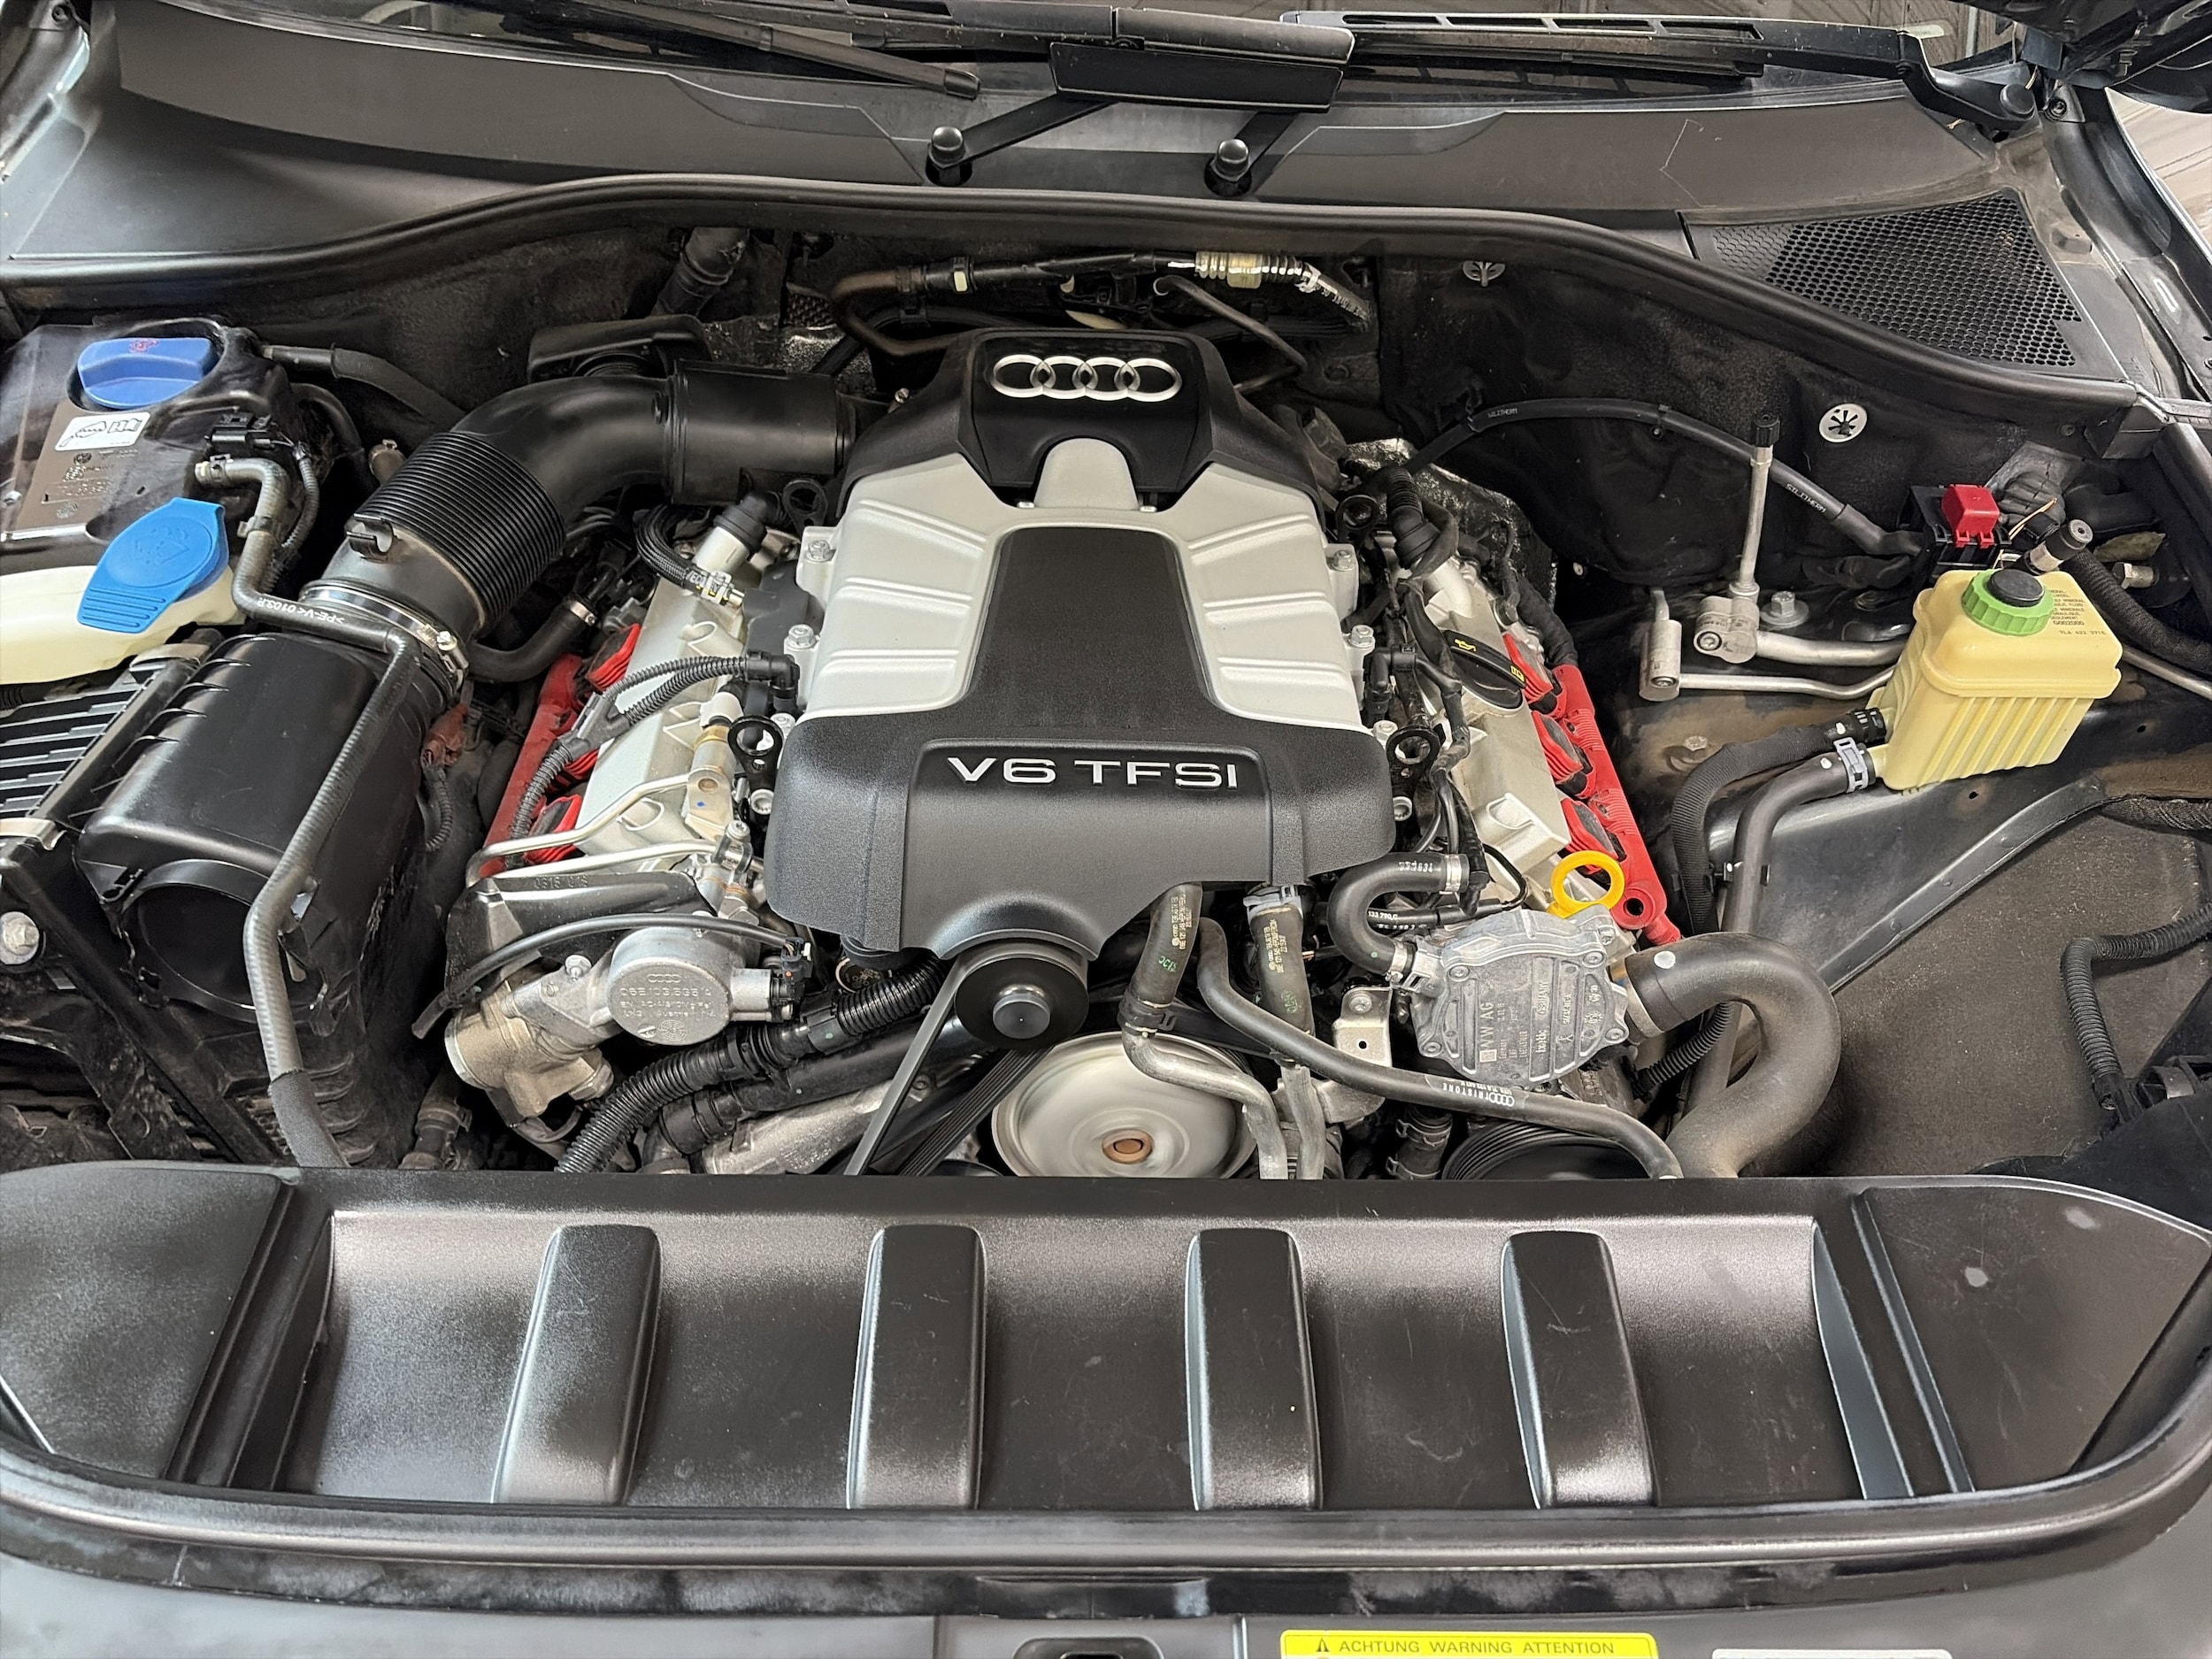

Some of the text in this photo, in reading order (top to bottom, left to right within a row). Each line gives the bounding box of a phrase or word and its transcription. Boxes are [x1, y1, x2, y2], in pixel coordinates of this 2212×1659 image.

[948, 757, 1238, 790] V6 TFSI
[1479, 1002, 1494, 1048] VW AG
[1442, 1082, 1489, 1101] TRISTONE
[1339, 1640, 1615, 1654] ACHTUNG WARNING ATTENTION
